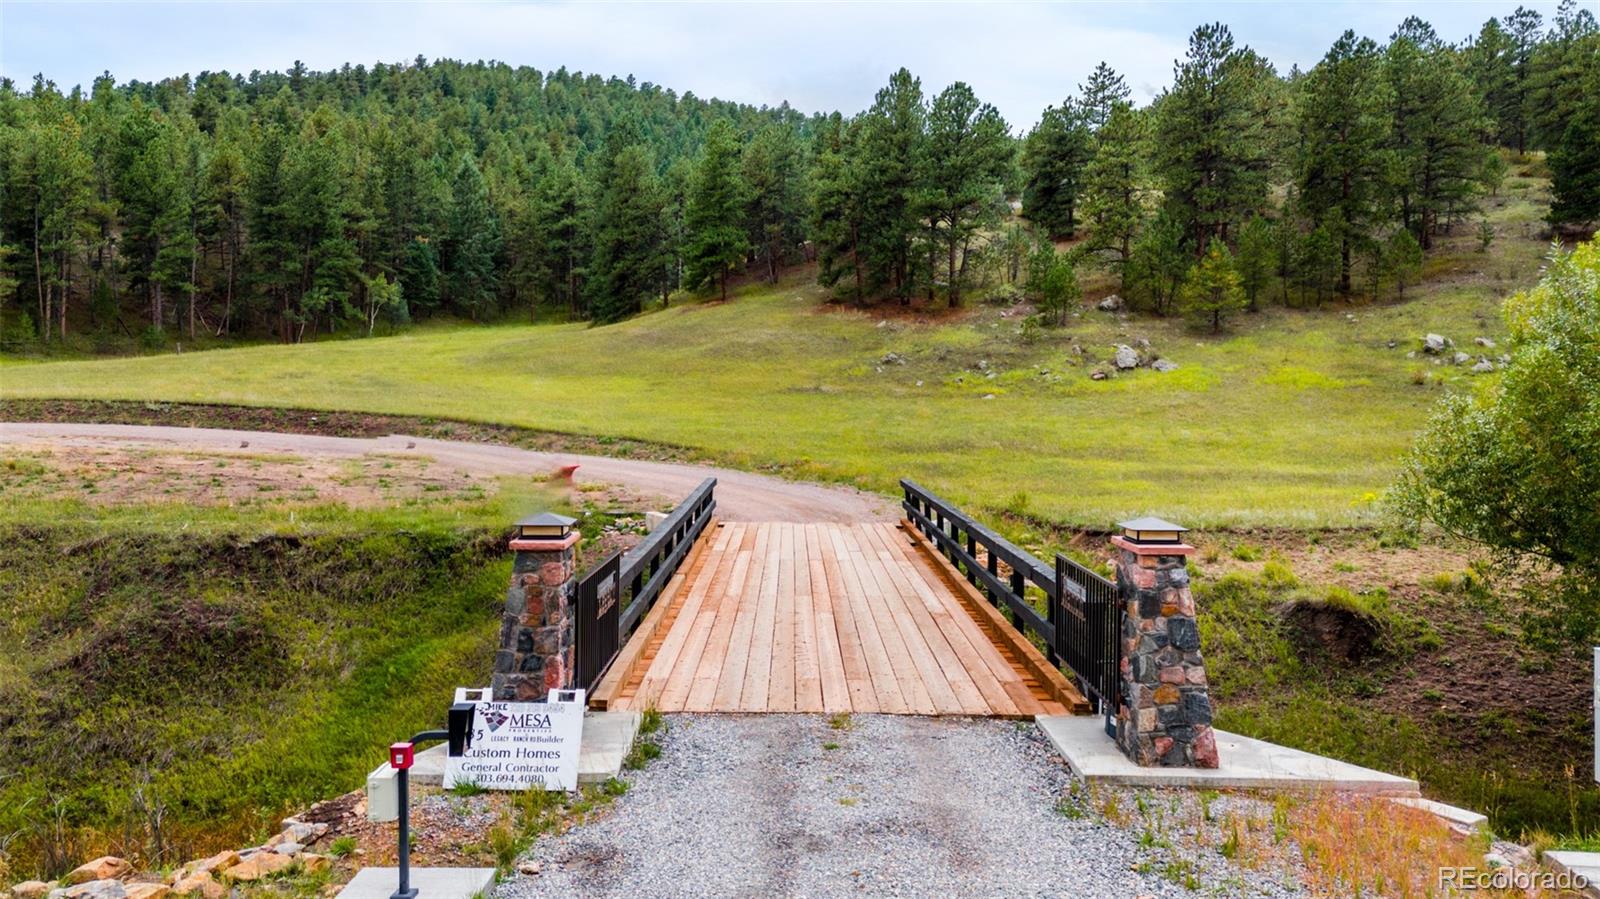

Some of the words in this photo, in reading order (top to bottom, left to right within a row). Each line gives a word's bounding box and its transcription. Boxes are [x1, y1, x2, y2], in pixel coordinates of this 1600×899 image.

[509, 714, 552, 728] MESA
[537, 735, 564, 744] Builder
[463, 747, 511, 759] Custom
[516, 749, 561, 759] Homes
[461, 762, 502, 772] General
[505, 763, 560, 773] Contractor
[475, 773, 545, 784] 303.694.4080
